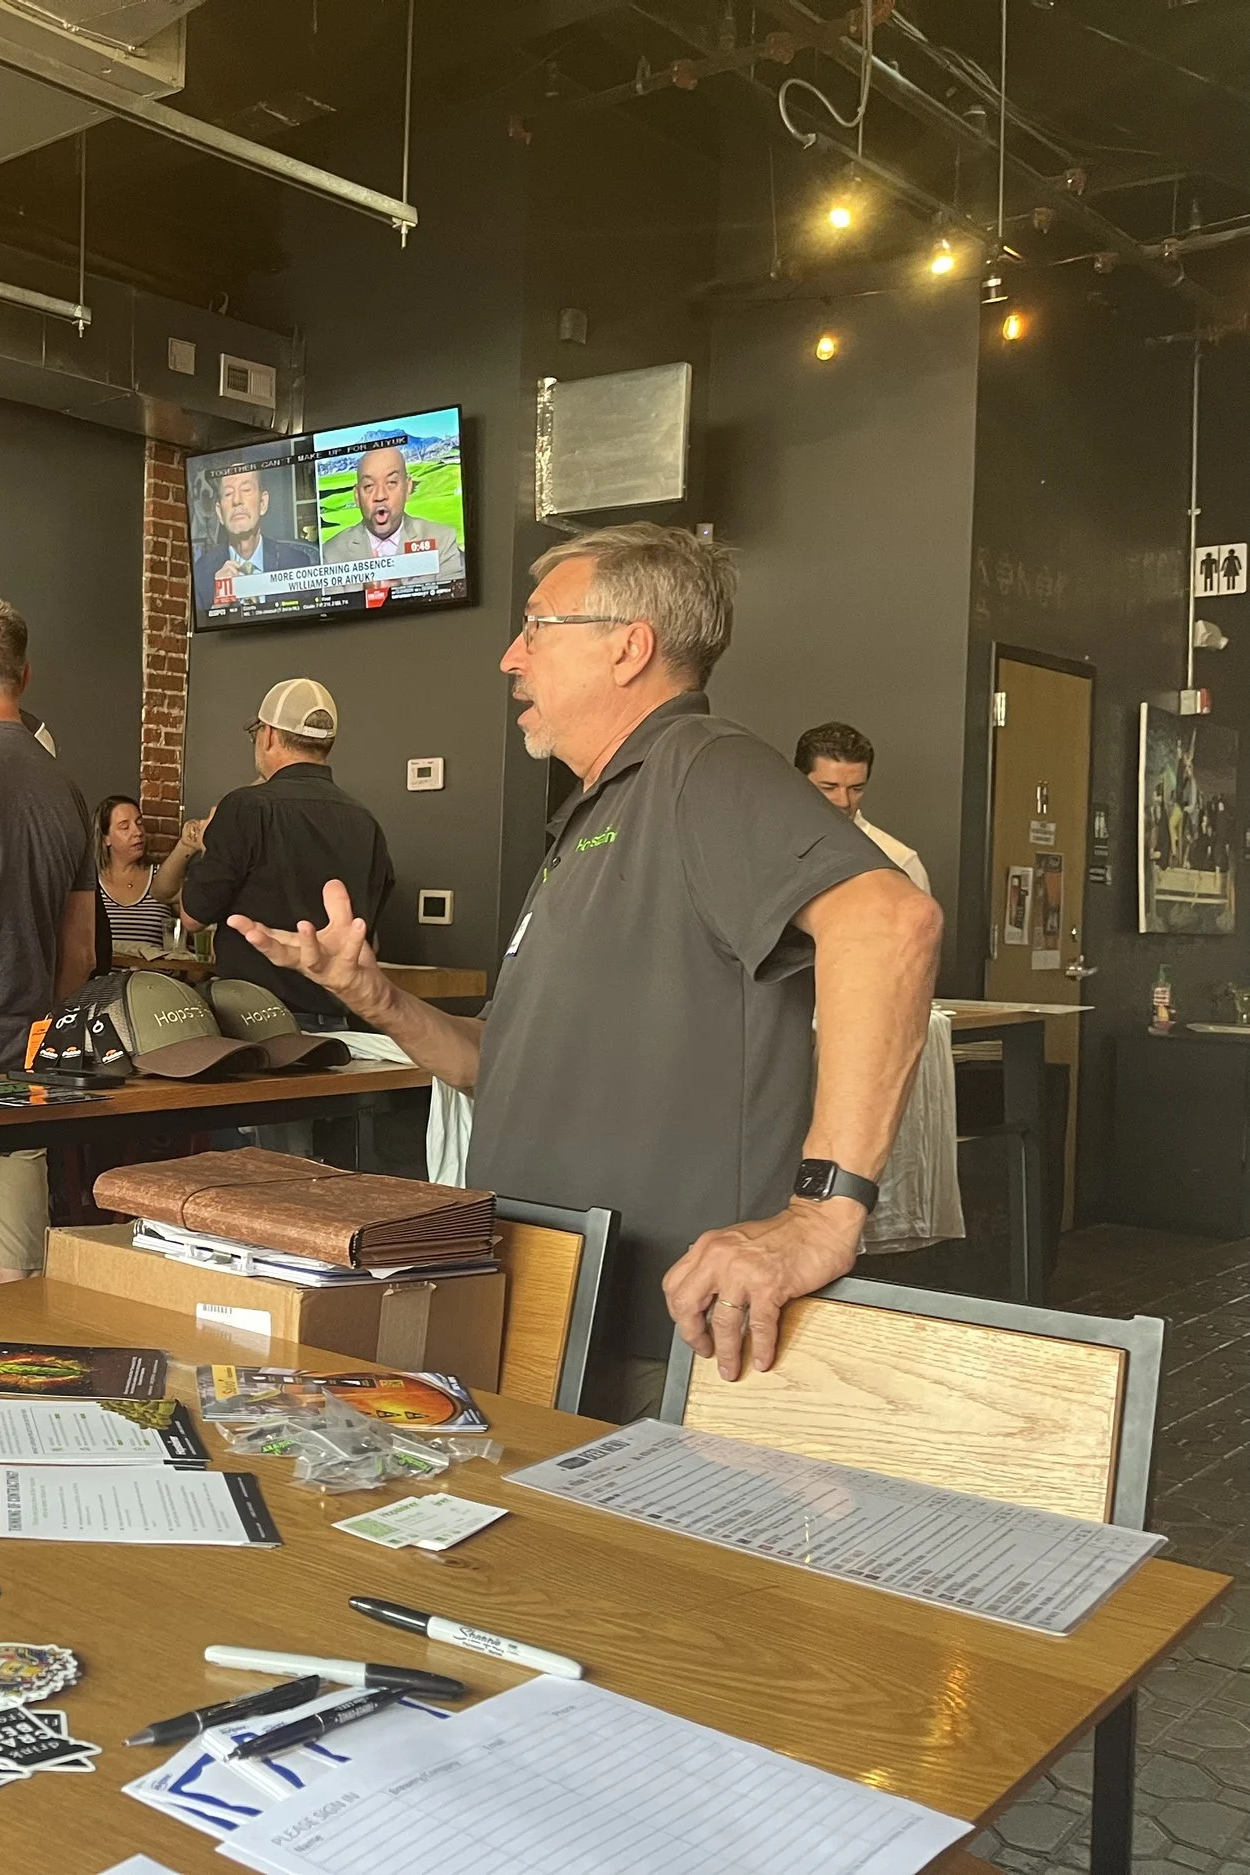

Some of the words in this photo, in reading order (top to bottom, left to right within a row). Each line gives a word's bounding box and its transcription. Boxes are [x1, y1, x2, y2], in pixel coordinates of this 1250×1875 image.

[210, 464, 258, 477] TOGETHER
[297, 451, 323, 462] MAKE
[329, 448, 342, 456] UP
[347, 443, 368, 454] FOR
[373, 437, 407, 449] AIYUK
[270, 571, 293, 582] MORE
[296, 564, 350, 580] CONCERNING
[352, 559, 395, 572] ABSENCE:
[288, 578, 329, 591] WILLIAMS
[331, 576, 343, 586] OR
[345, 573, 375, 585] AIYUK?
[9, 1741, 61, 1759] drink
[271, 1817, 319, 1847] PLEASE
[317, 1799, 348, 1826] SIGN
[347, 1791, 362, 1807] IN
[294, 1834, 324, 1852] Name
